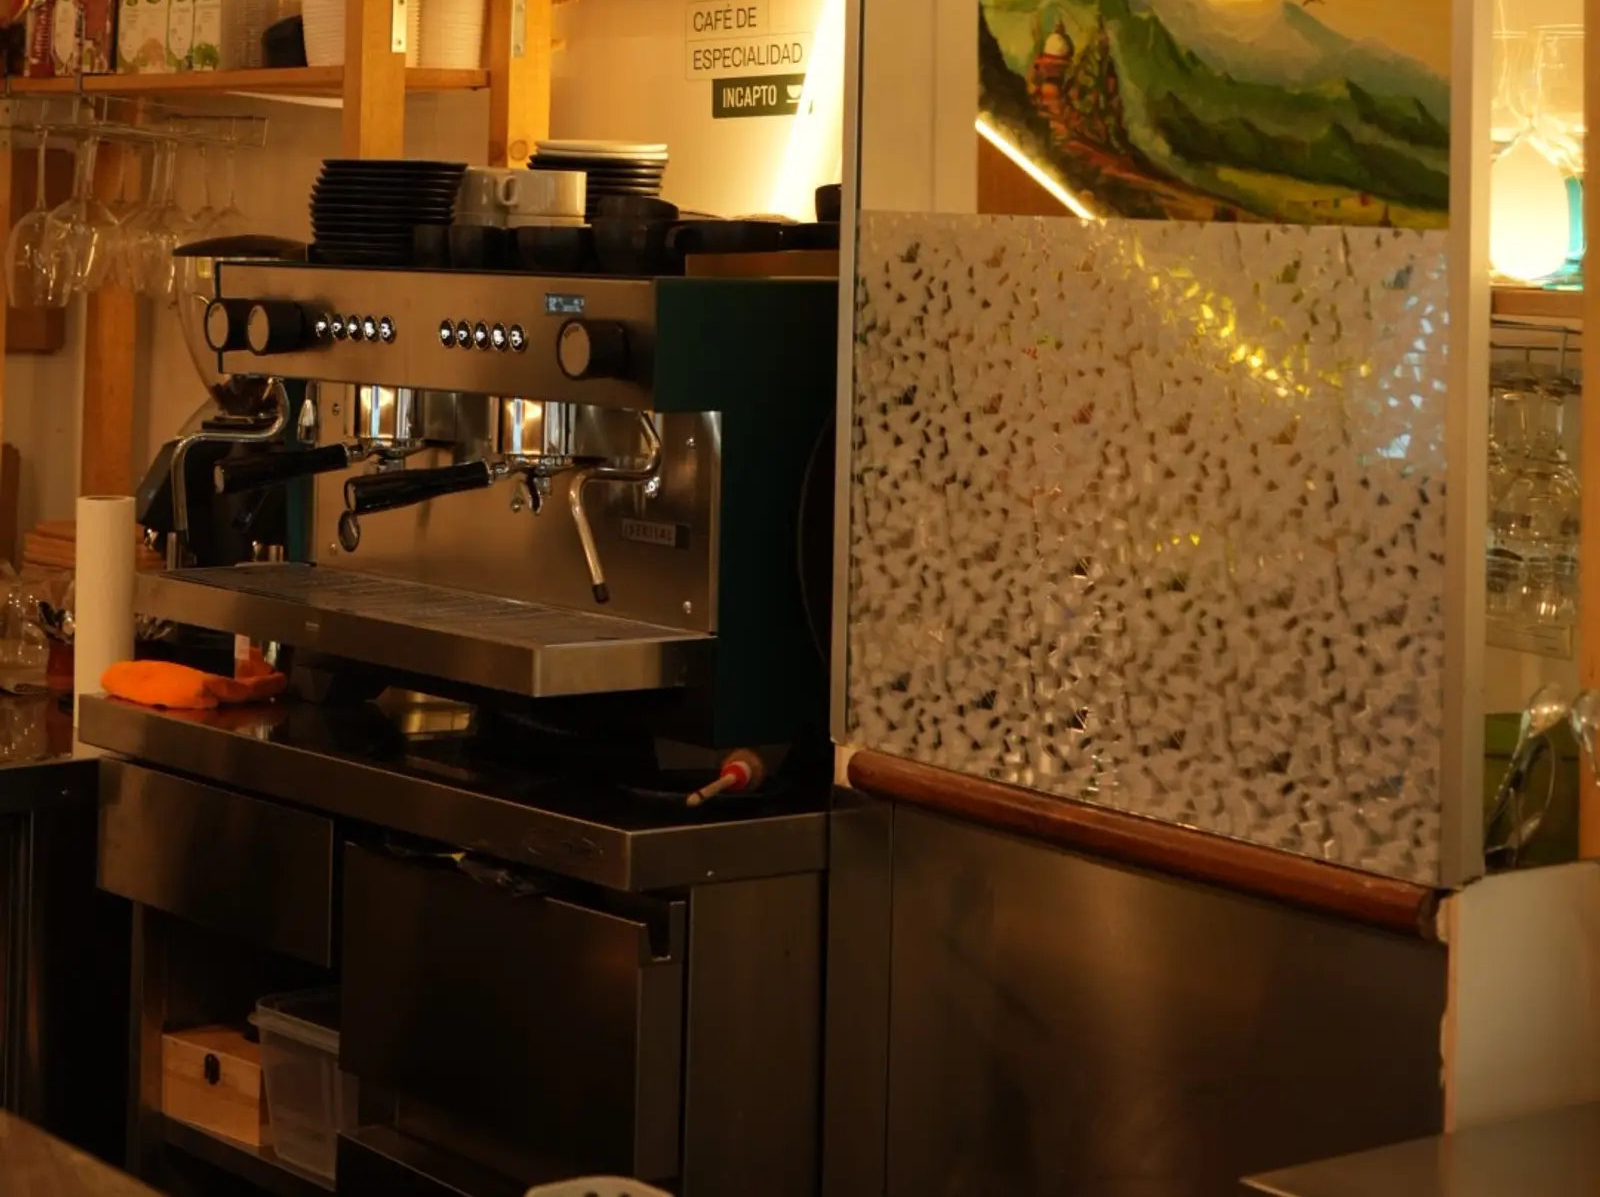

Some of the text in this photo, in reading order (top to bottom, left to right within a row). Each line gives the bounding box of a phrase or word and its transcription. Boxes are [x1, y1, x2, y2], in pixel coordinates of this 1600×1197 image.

[692, 3, 757, 32] CAFÉ DE
[692, 42, 803, 70] ESPECIALIDAD
[722, 84, 777, 108] INCAPTO
